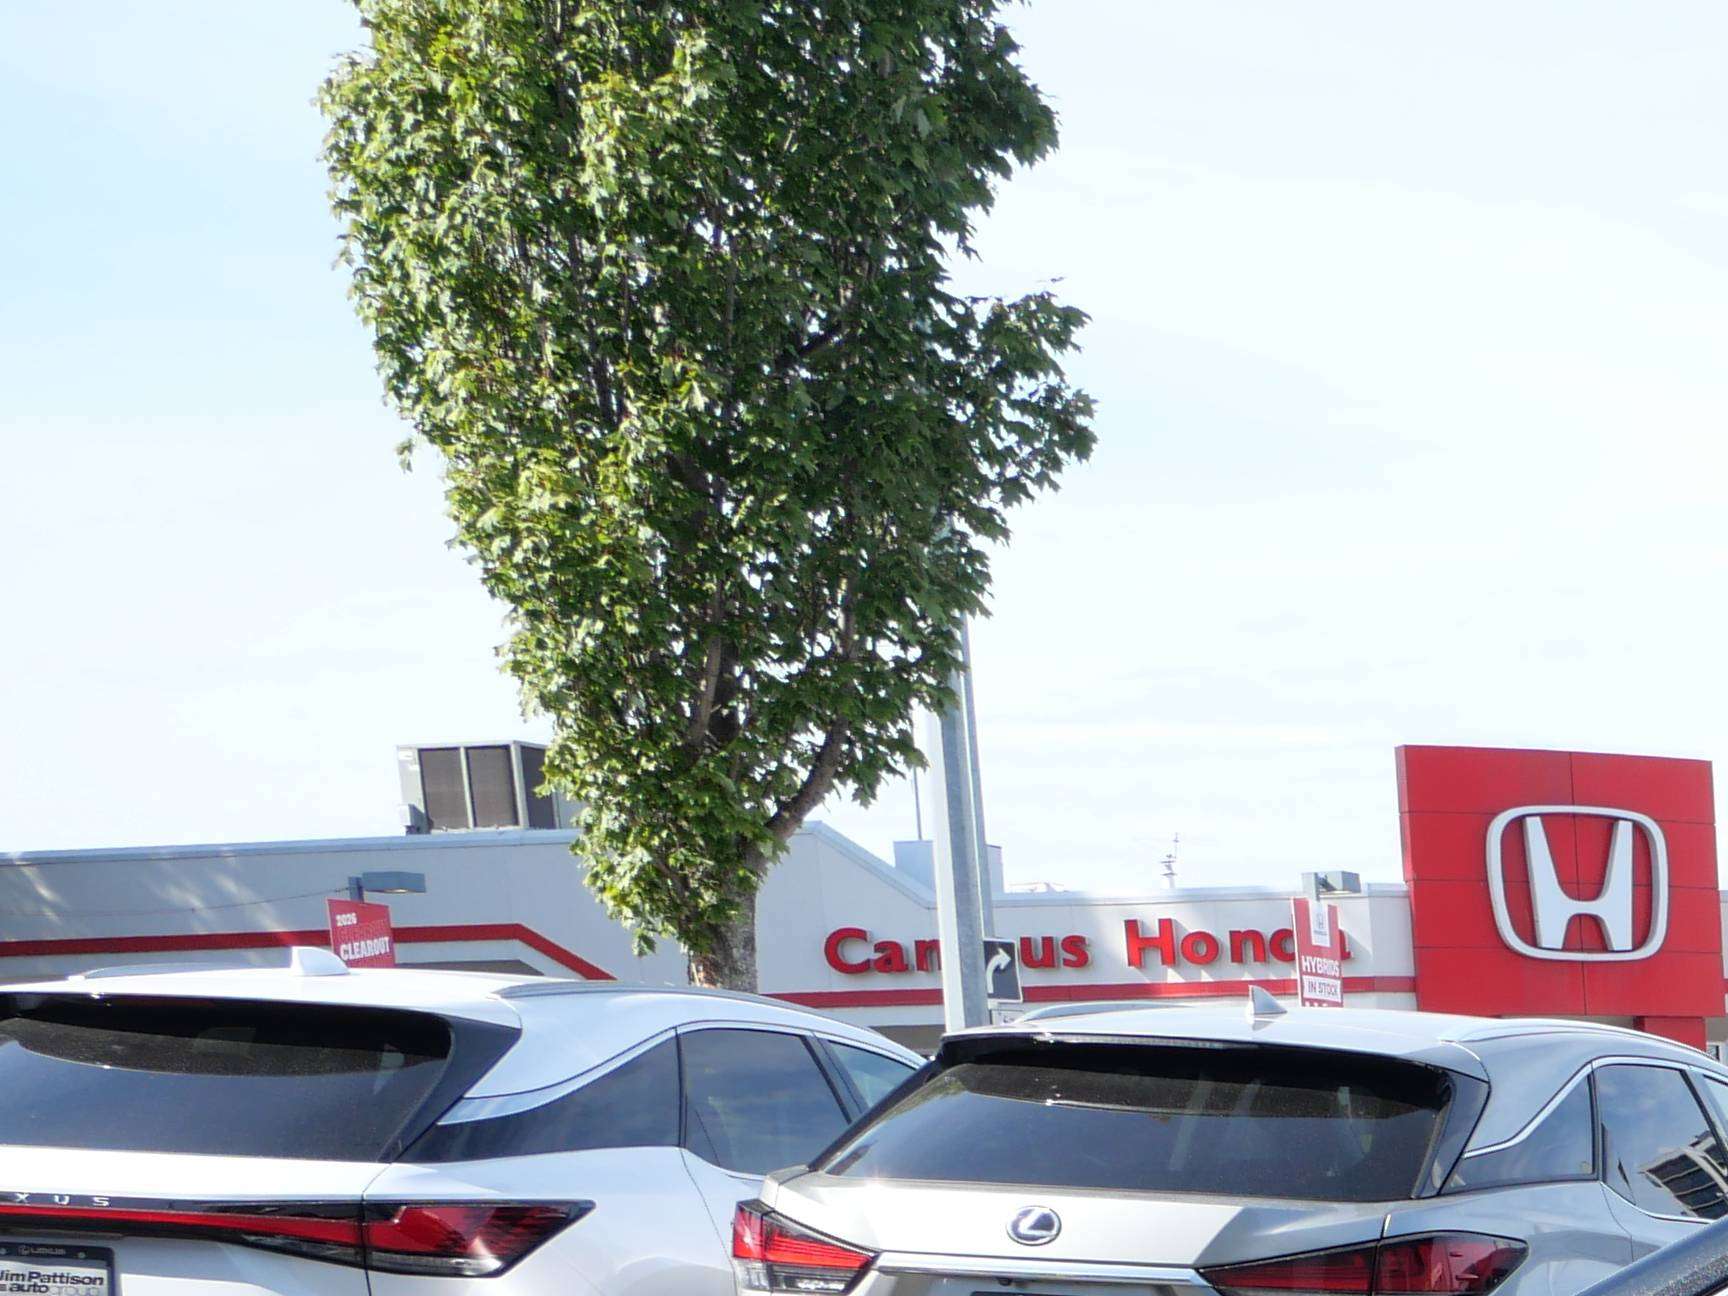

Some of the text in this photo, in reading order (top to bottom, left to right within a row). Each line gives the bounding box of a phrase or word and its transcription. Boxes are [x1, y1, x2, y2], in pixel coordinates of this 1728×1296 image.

[340, 936, 390, 961] CLEAROUT
[823, 917, 1351, 976] Caus Hon
[1301, 955, 1340, 977] HYBRIDS
[1308, 980, 1338, 996] IN STOCK
[28, 1271, 104, 1286] Pattison
